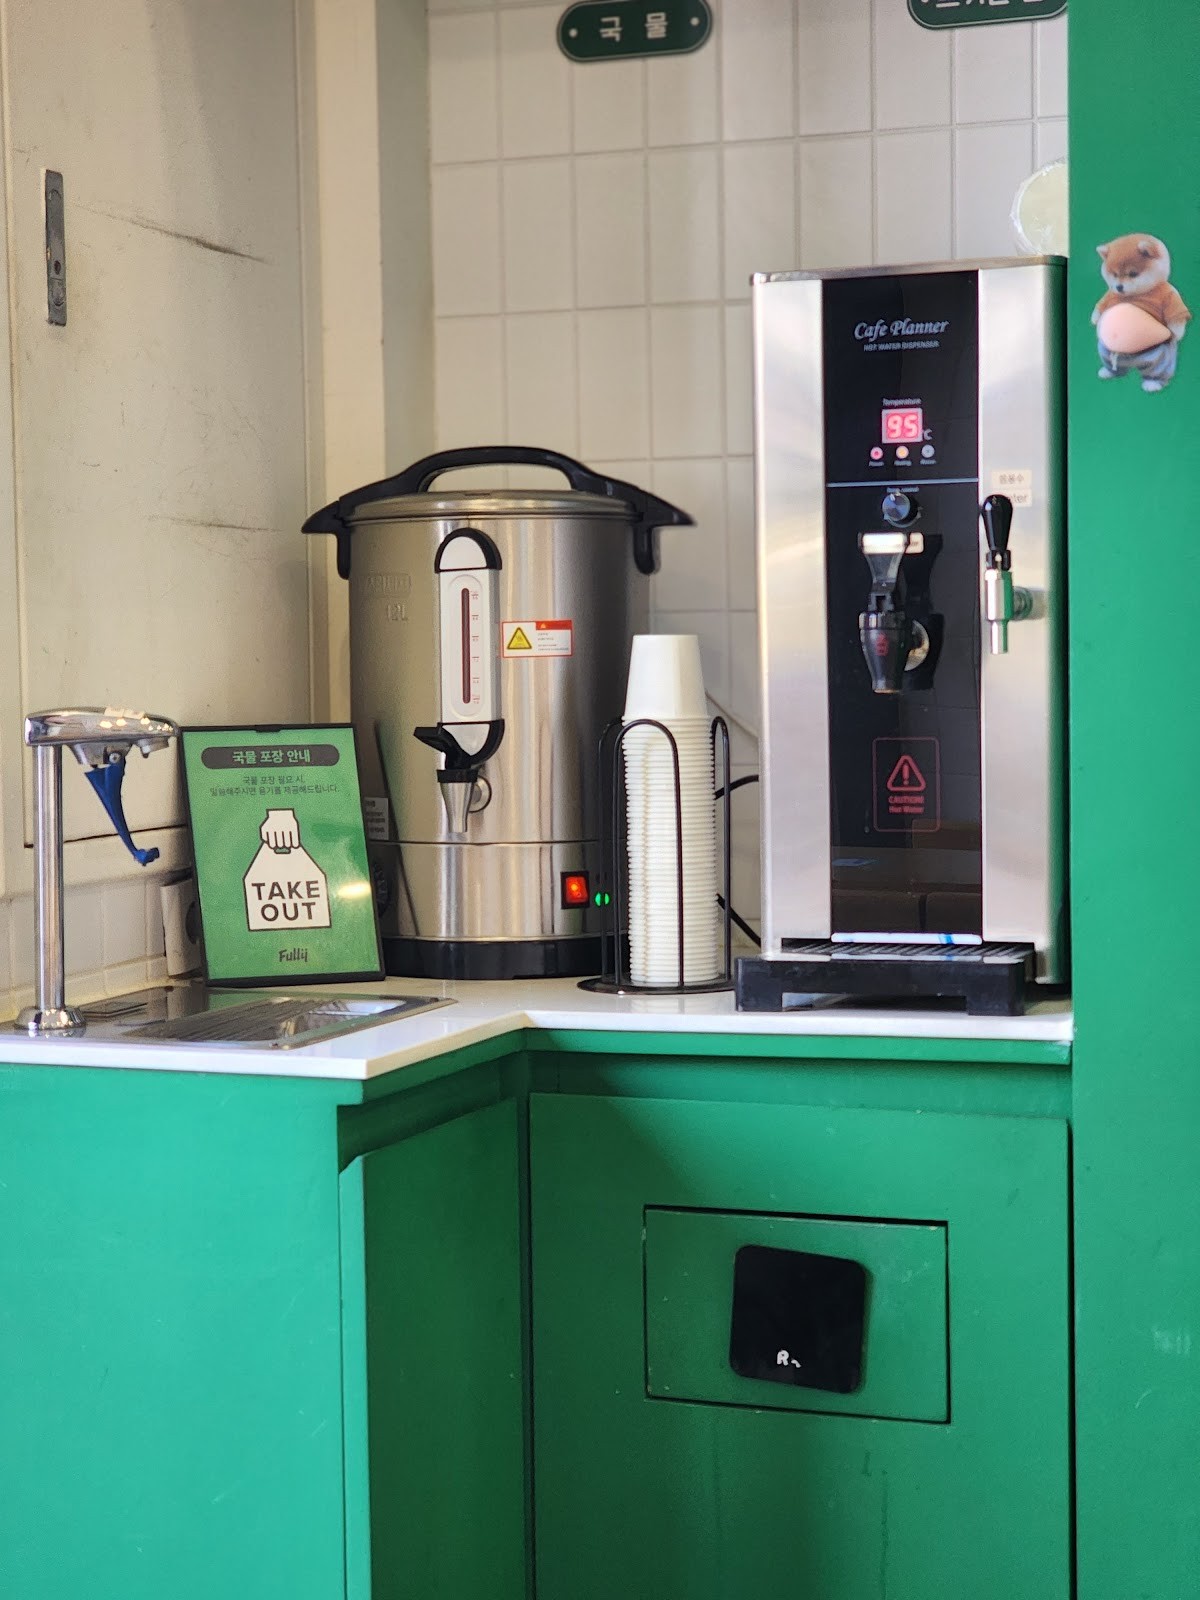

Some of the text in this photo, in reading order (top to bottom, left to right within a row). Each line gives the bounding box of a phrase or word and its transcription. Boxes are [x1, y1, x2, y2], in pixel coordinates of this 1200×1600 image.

[854, 317, 950, 342] Cafe Planner
[878, 342, 901, 351] WATER
[901, 340, 940, 350] DISPENSER
[887, 414, 918, 439] 95
[232, 749, 311, 764] 국물 포장 안내
[243, 775, 258, 786] 국물
[261, 775, 275, 785] 포장
[278, 775, 294, 785] 필요
[251, 880, 320, 901] TAKE
[261, 902, 316, 922] OUT
